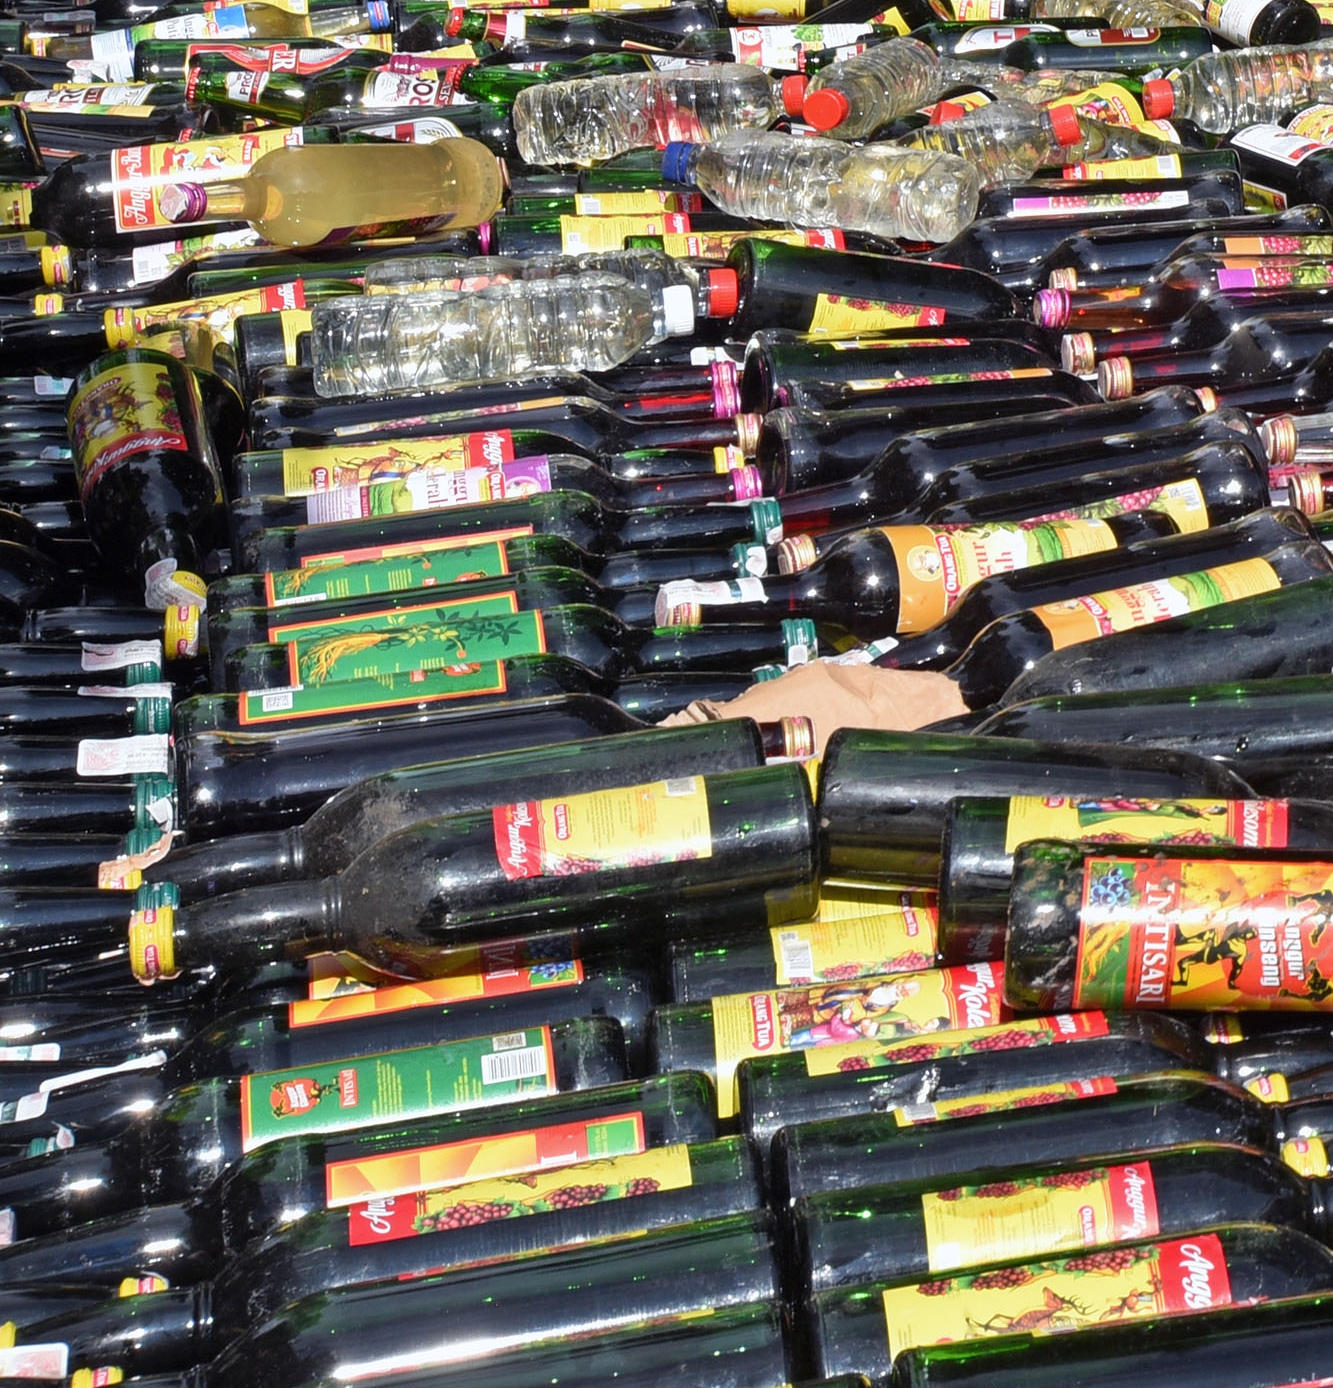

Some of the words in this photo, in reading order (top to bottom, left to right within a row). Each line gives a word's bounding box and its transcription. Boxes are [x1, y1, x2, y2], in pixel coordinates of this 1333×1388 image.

[938, 535, 951, 553] TUA
[945, 553, 959, 591] ORANG
[556, 817, 569, 840] ORANG
[507, 825, 529, 876] Anggur
[1136, 881, 1175, 1003] INTISARI
[753, 995, 769, 1023] ORANG
[756, 1023, 771, 1048] TUA
